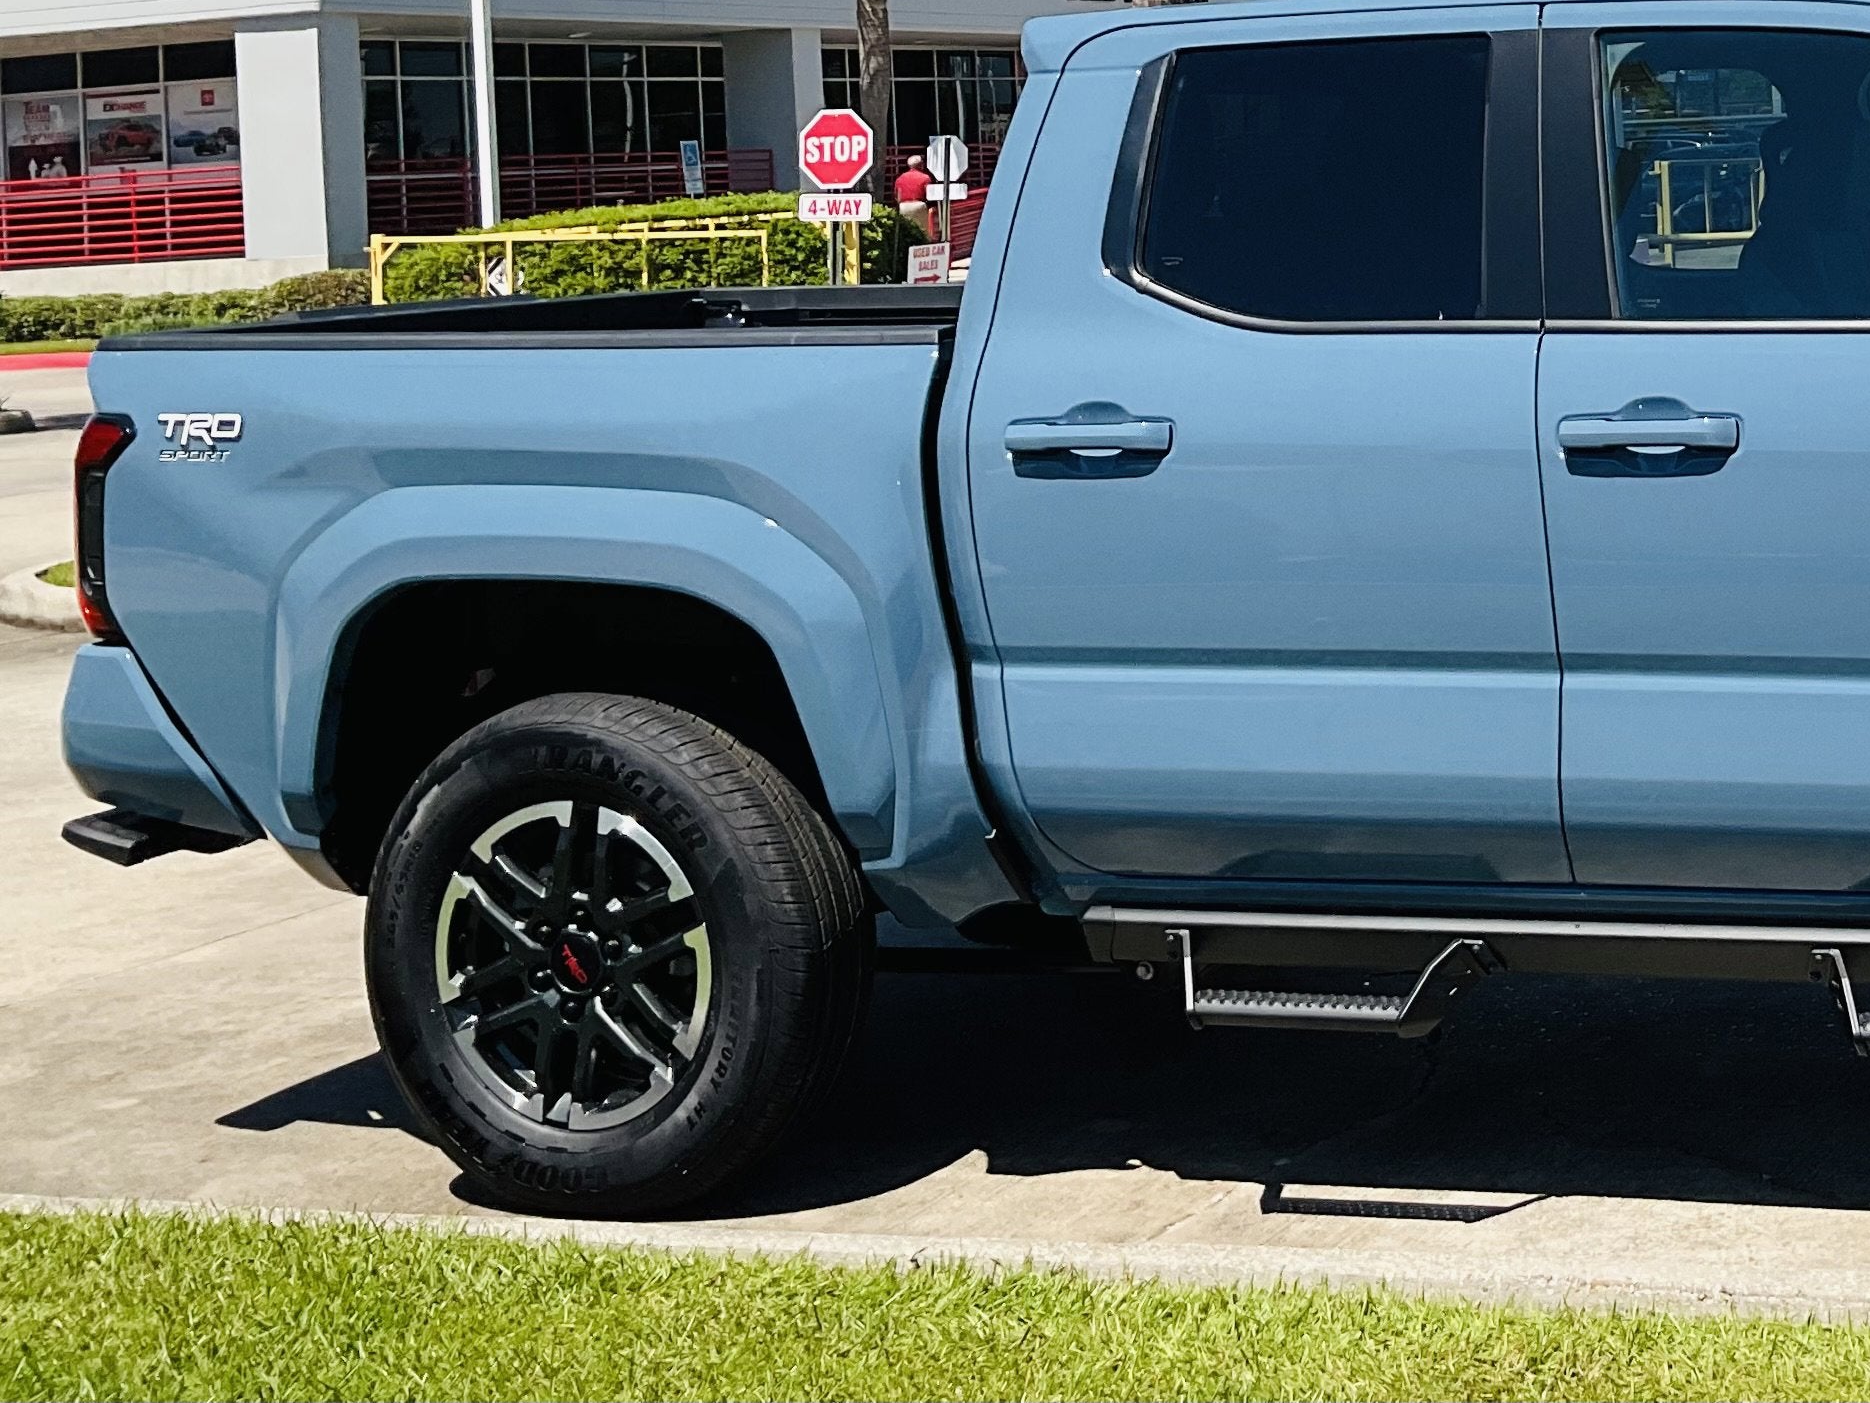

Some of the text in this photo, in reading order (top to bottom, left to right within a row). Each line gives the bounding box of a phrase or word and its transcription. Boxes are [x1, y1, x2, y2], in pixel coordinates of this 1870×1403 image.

[805, 135, 867, 164] STOP
[807, 199, 862, 216] 4-WAY
[912, 247, 931, 258] USED
[157, 412, 243, 447] TRD
[158, 449, 232, 463] SPORT
[560, 943, 589, 985] TRD
